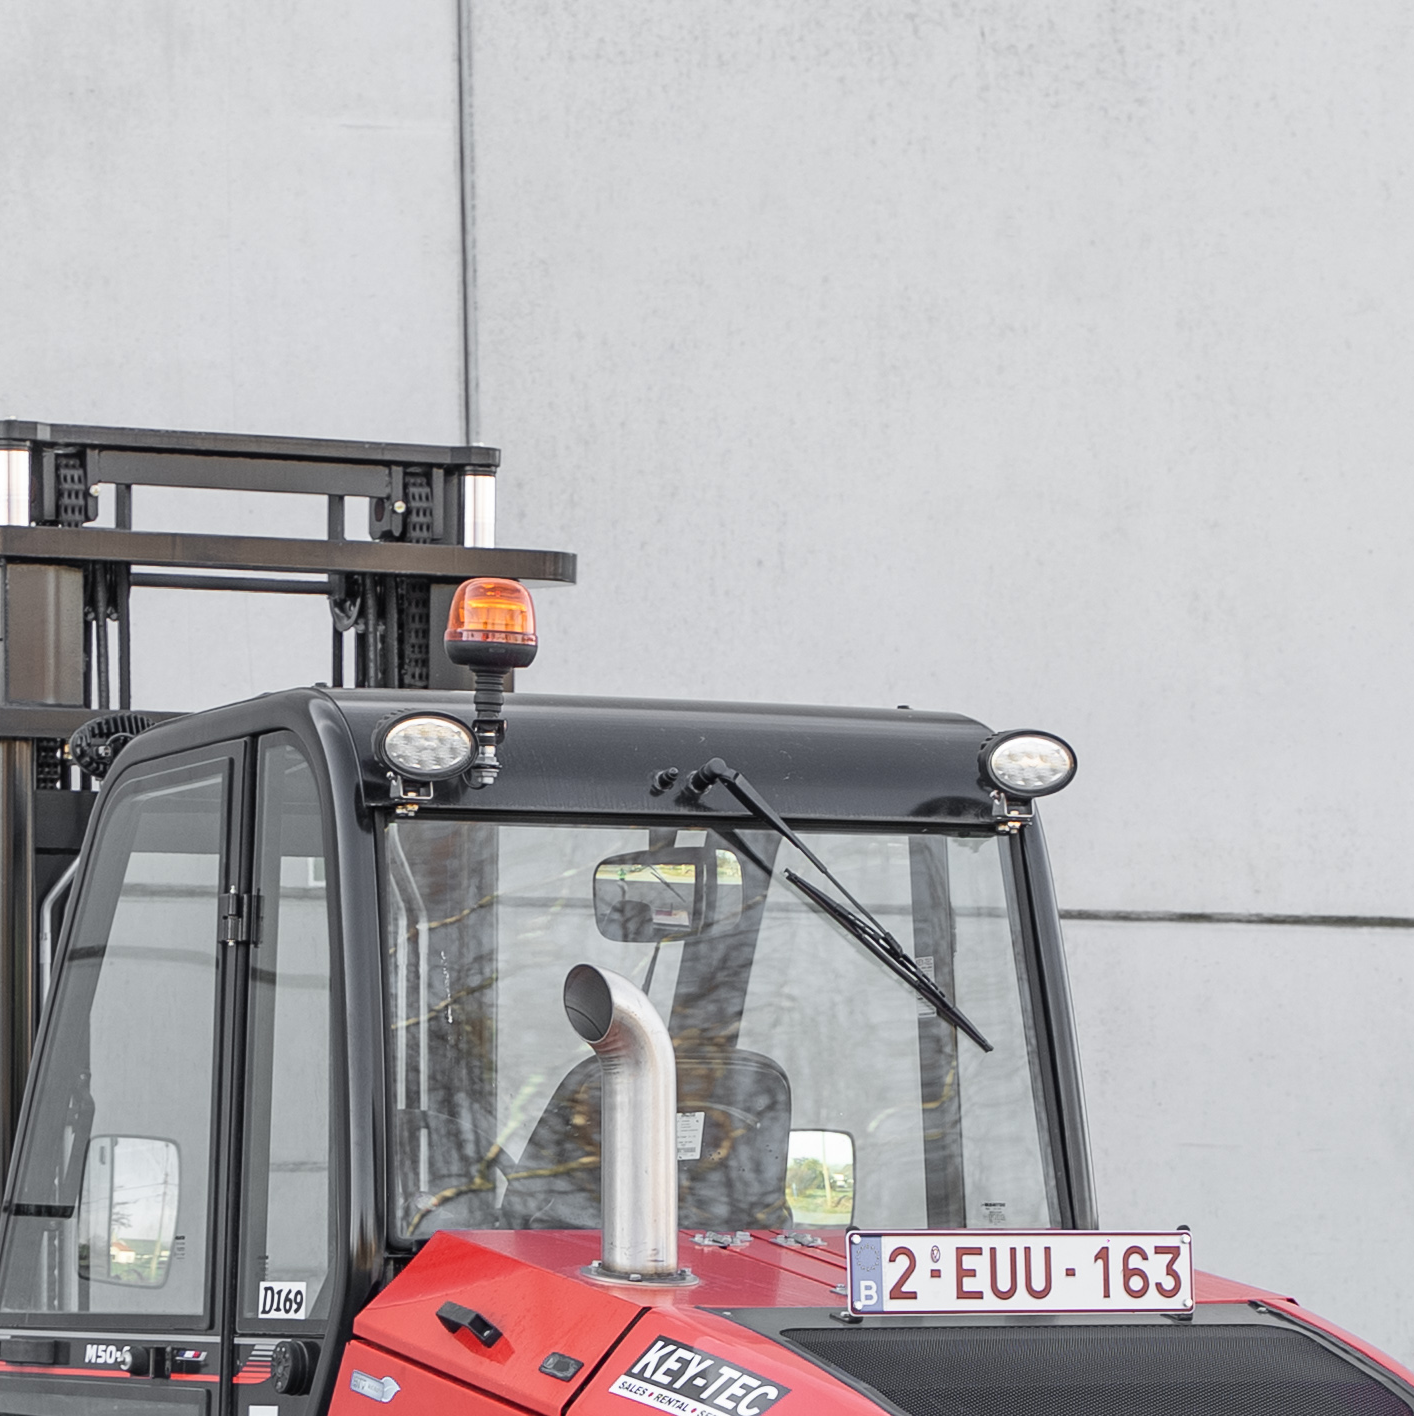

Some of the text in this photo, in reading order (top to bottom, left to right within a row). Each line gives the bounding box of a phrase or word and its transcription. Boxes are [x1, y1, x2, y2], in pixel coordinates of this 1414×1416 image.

[888, 1245, 1182, 1301] 2-EUU-163
[260, 1285, 304, 1315] D169
[859, 1280, 879, 1306] B
[631, 1340, 779, 1416] KEY-TEC
[618, 1380, 648, 1396] SALES
[653, 1393, 688, 1413] RENTAL
